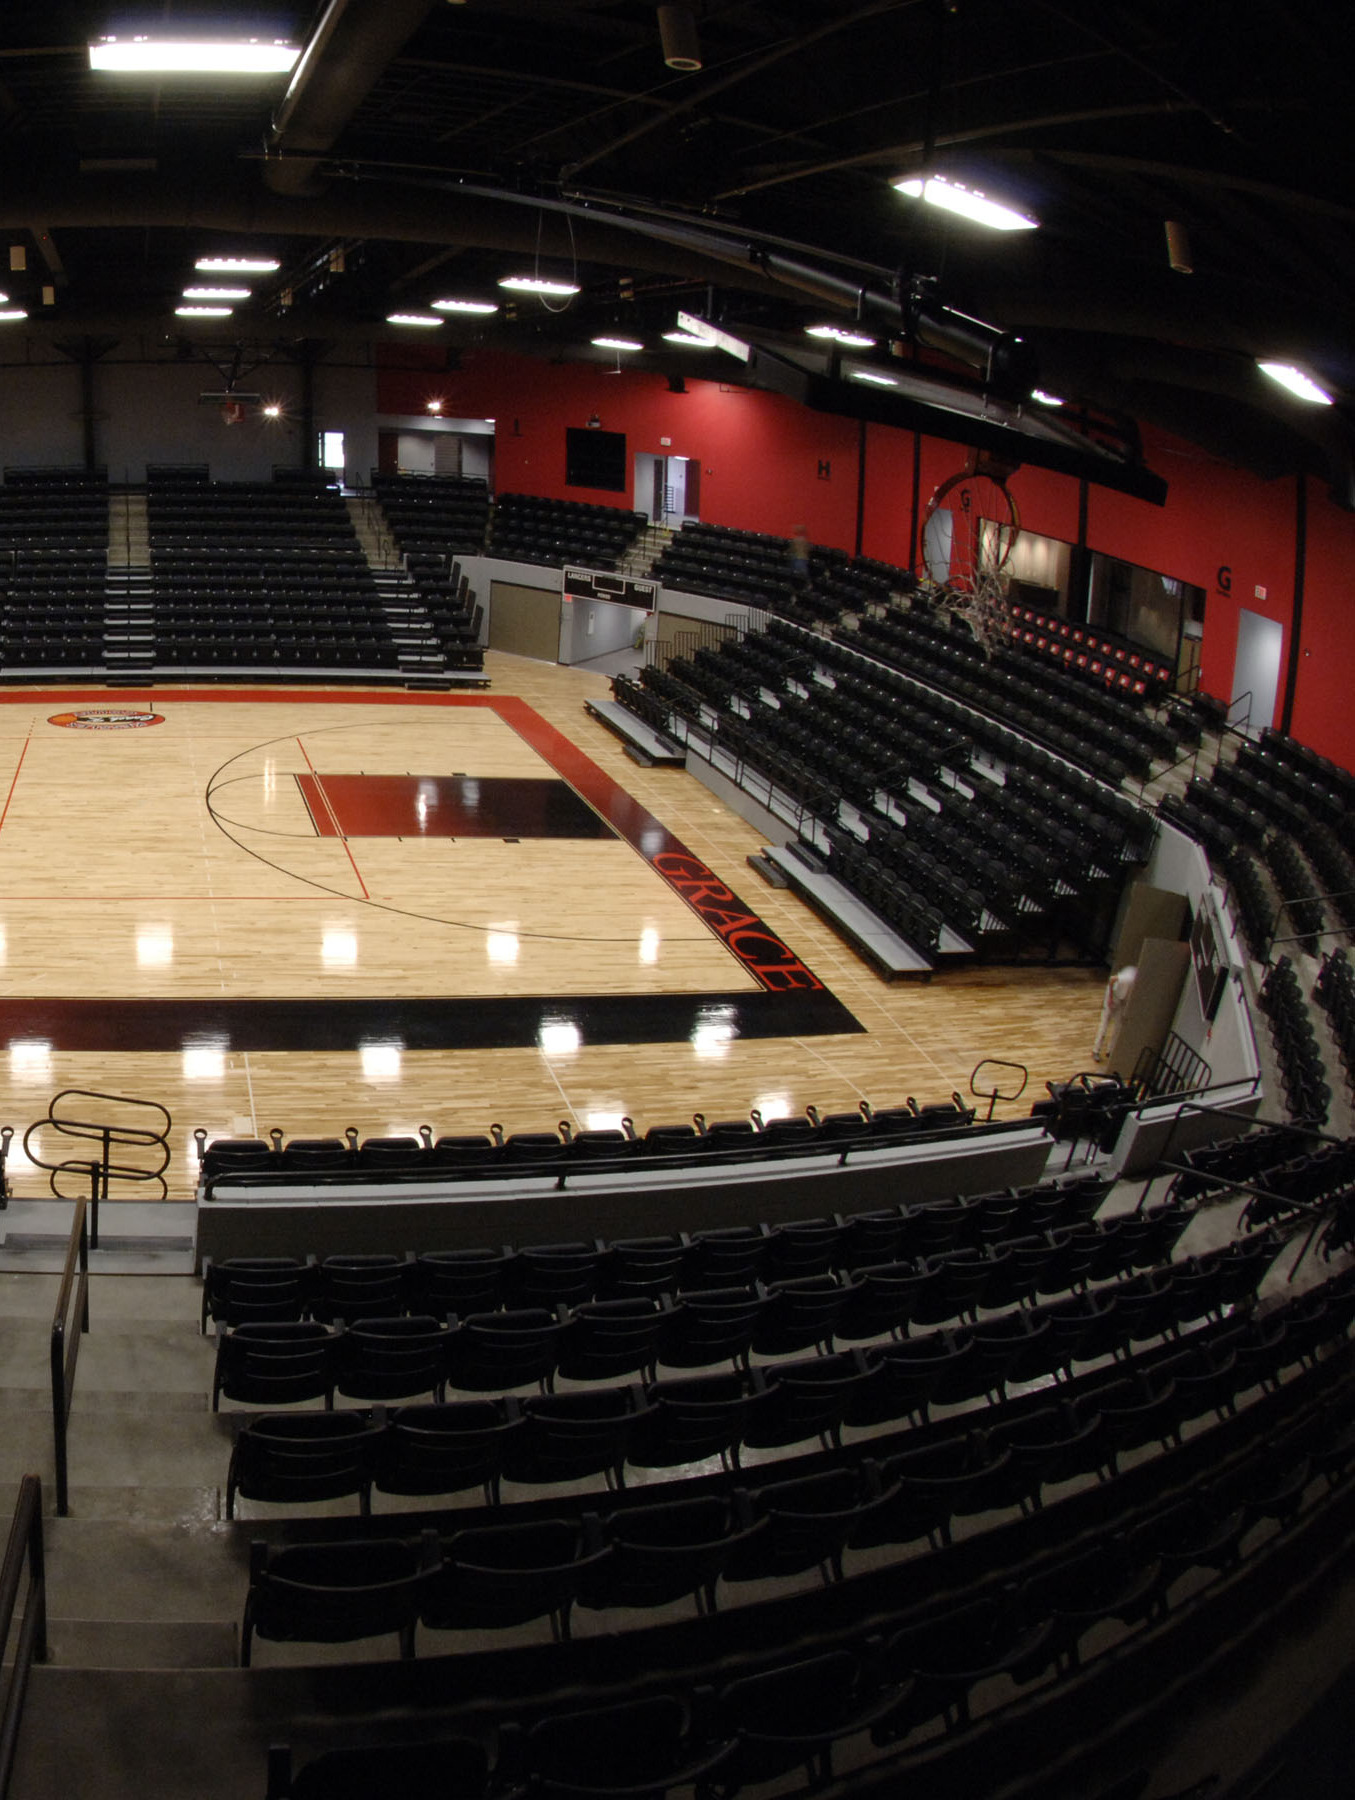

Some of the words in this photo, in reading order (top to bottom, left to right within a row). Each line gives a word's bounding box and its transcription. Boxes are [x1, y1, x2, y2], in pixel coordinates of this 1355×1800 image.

[817, 459, 831, 477] H
[1217, 566, 1233, 592] G
[652, 852, 826, 993] GRACE
